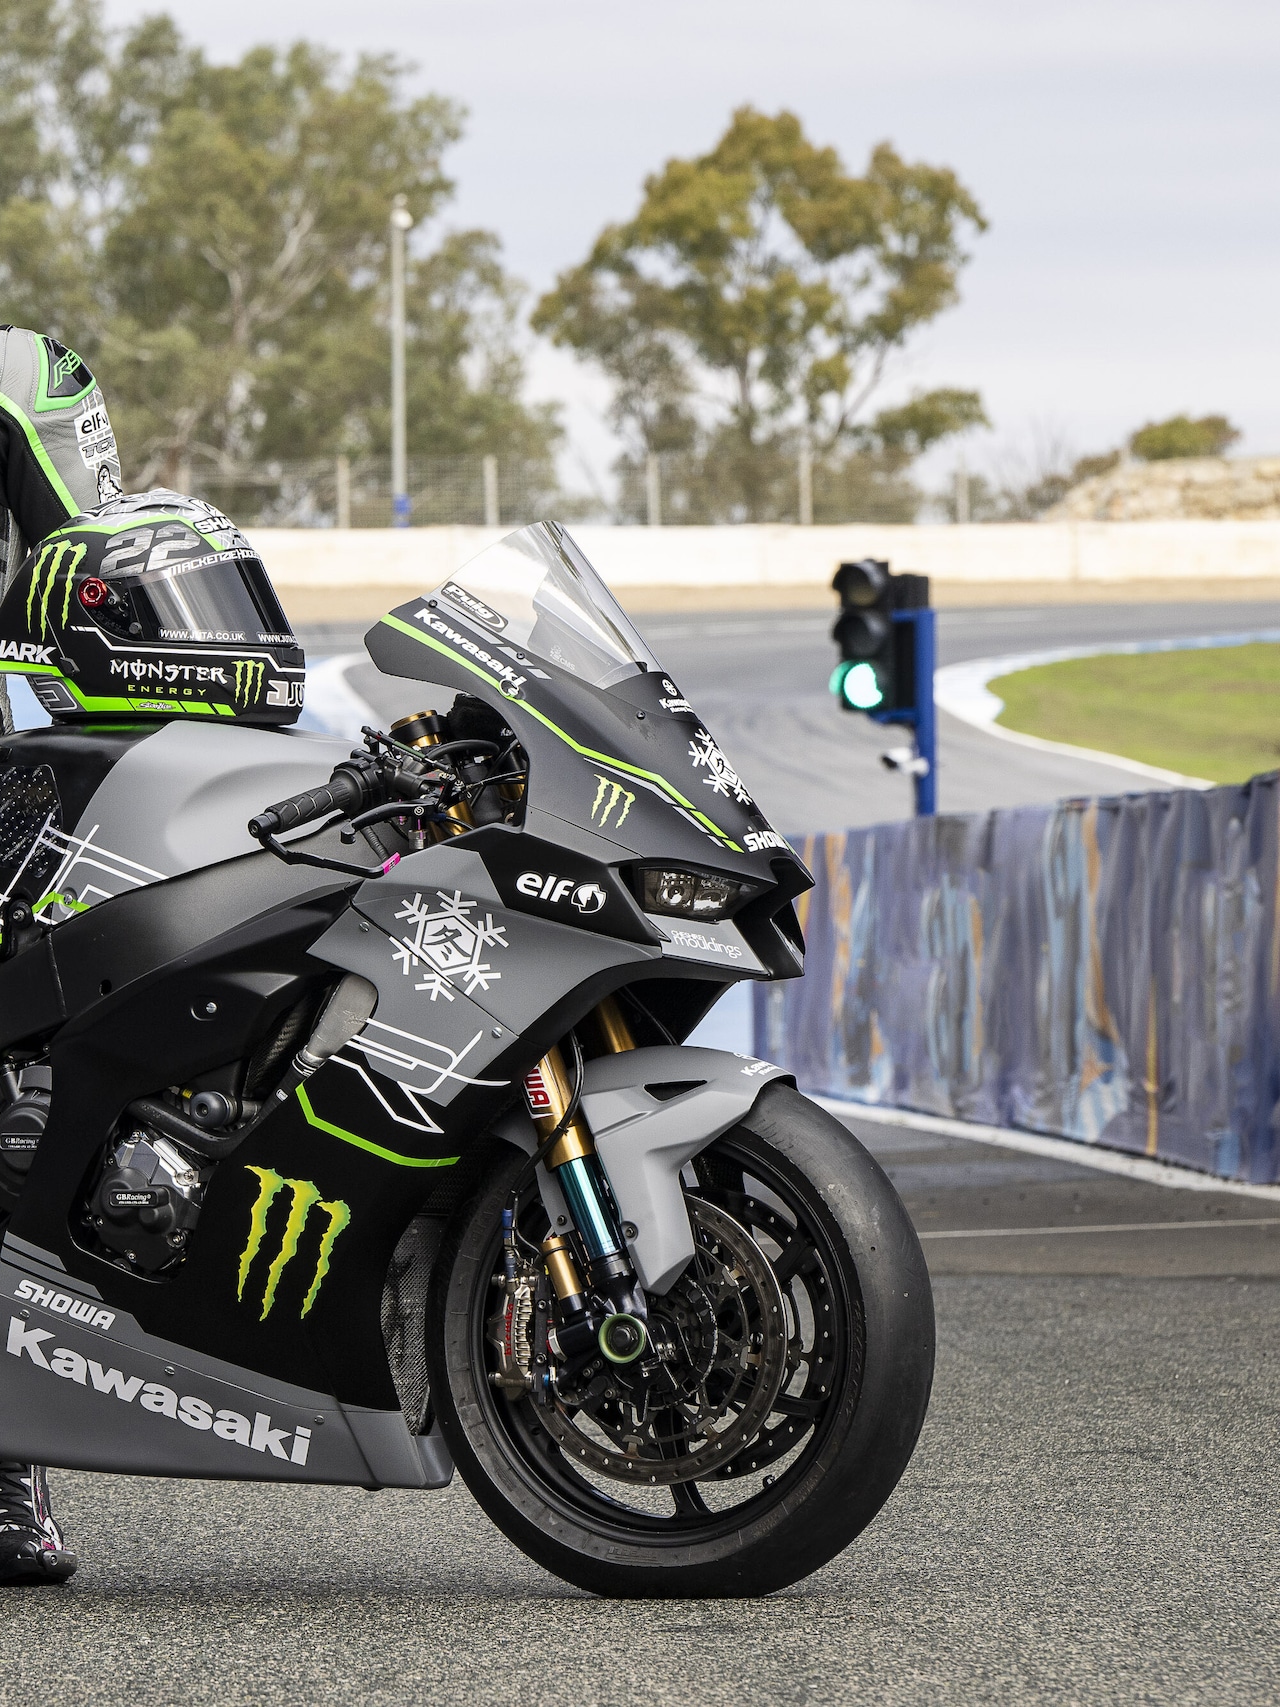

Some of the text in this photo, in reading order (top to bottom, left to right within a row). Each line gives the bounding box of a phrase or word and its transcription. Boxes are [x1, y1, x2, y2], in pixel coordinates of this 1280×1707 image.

[80, 411, 103, 435] elf
[194, 516, 239, 534] SHA
[99, 523, 201, 578] 22
[446, 584, 496, 619] Puig
[413, 607, 528, 688] Kawasaki
[109, 658, 228, 685] MONSTER
[127, 684, 207, 696] ENERGY
[515, 871, 575, 903] elf
[673, 933, 742, 959] mouldings
[13, 1278, 117, 1331] SHOWA
[6, 1315, 313, 1467] Kawasaki
